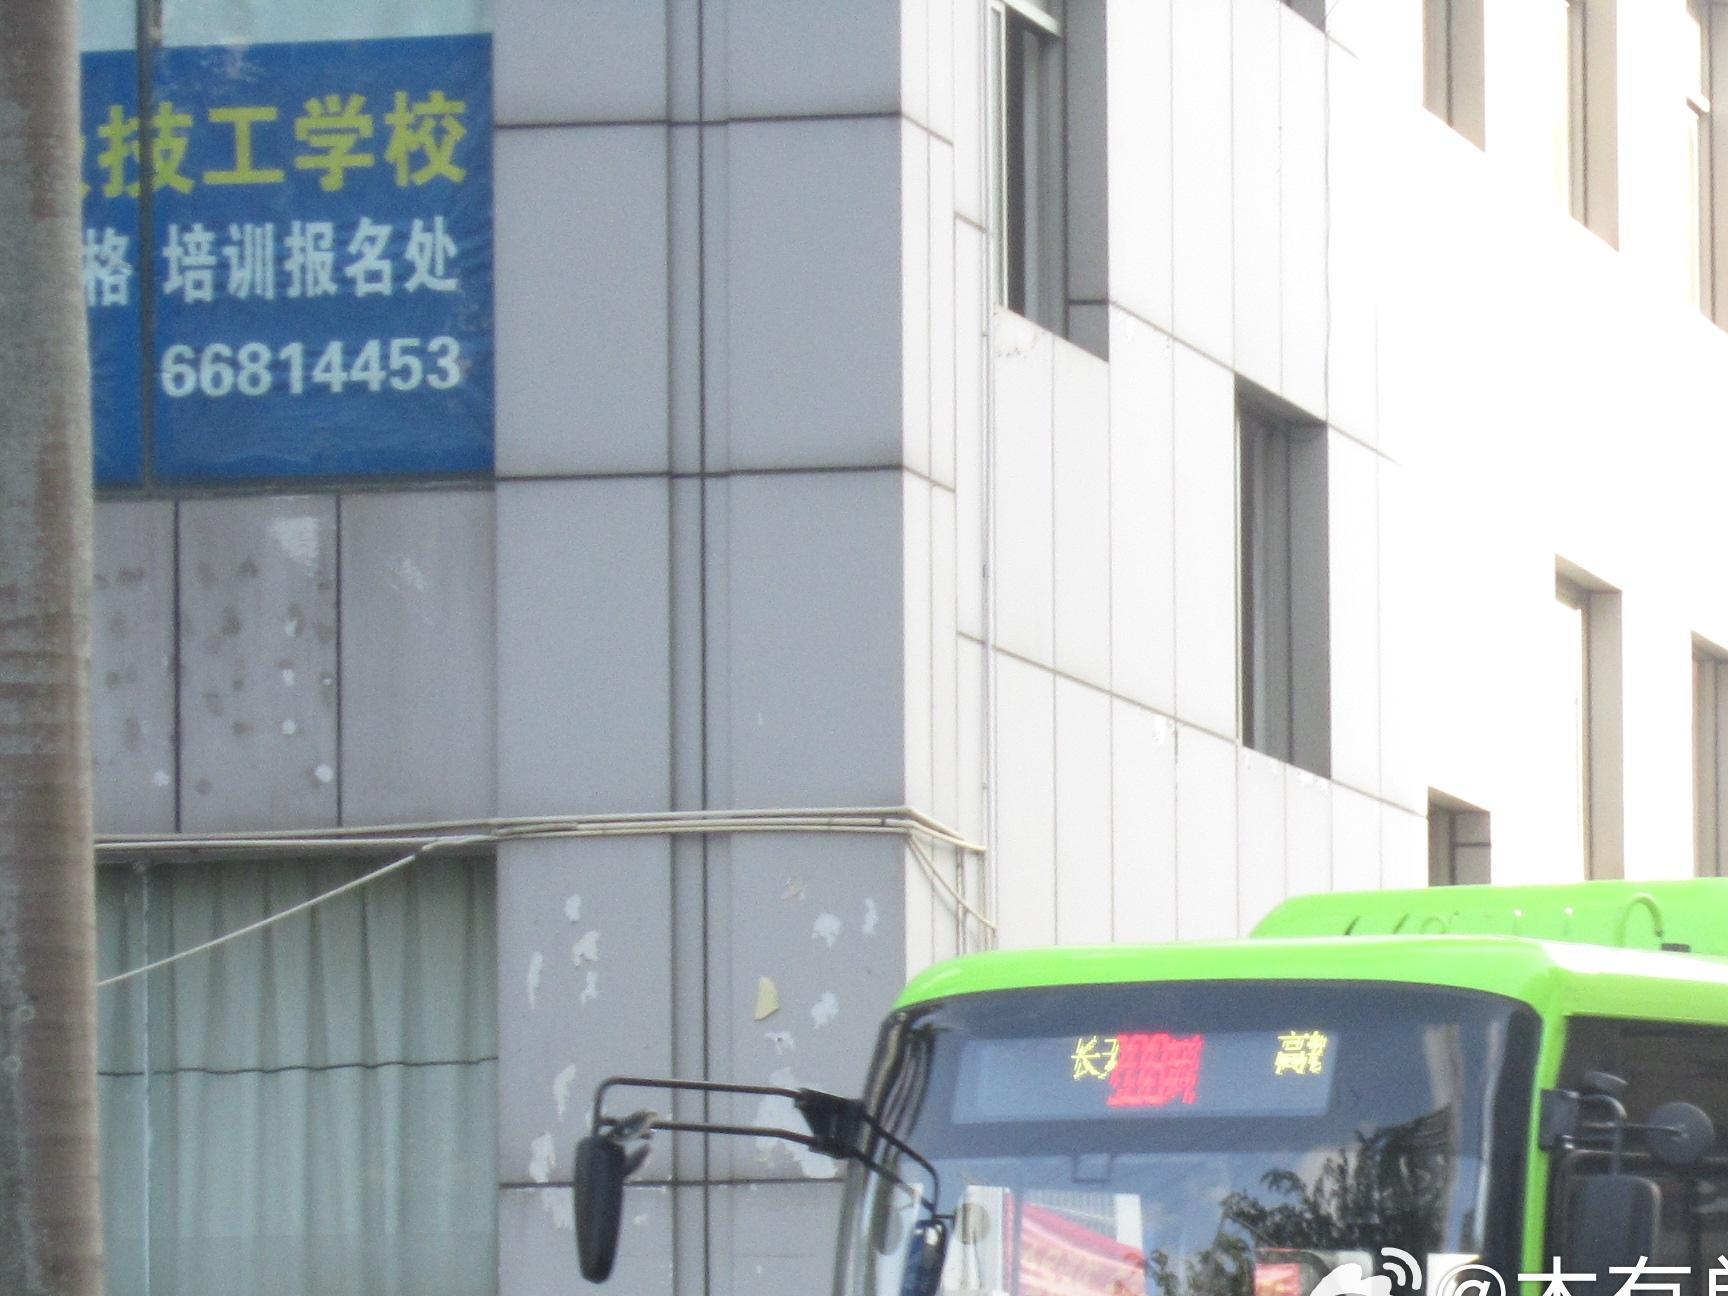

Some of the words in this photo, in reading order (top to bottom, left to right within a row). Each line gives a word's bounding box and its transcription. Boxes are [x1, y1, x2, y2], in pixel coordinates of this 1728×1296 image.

[80, 91, 467, 198] 技工学校
[162, 216, 459, 302] 培训报名处
[161, 336, 462, 397] 66814453
